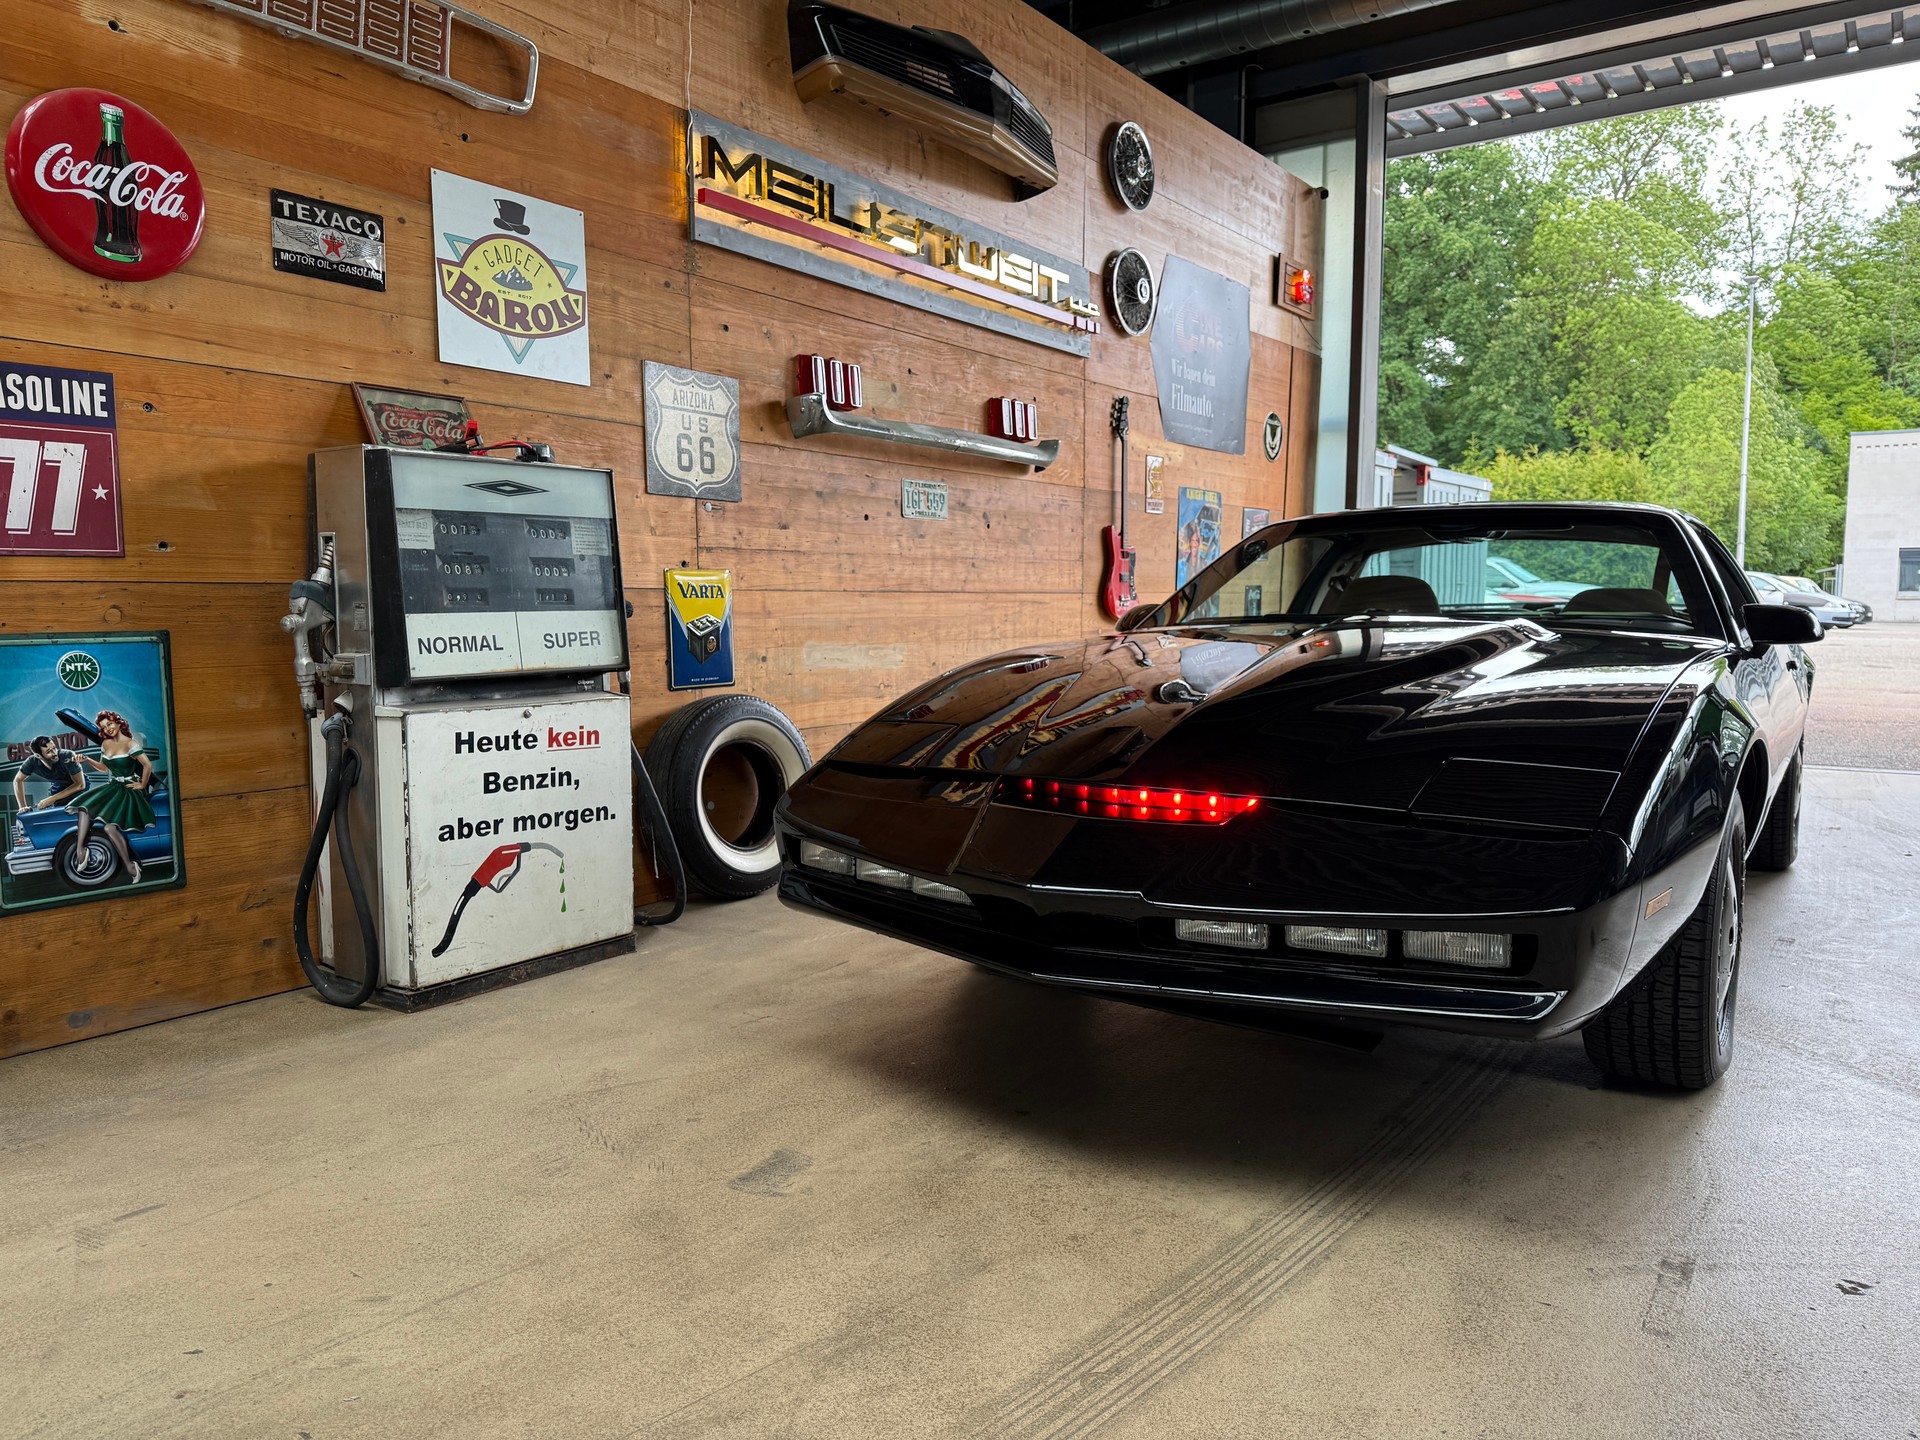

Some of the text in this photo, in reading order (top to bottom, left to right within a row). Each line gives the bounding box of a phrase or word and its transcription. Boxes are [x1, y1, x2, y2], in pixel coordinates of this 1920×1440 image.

[34, 142, 189, 218] Coca-Cola
[277, 198, 382, 240] TEXACO
[280, 251, 384, 282] MOTOR OIL GASOLINE
[483, 244, 545, 278] GADGET
[447, 269, 581, 332] BARON
[672, 388, 715, 411] ARIZONA
[1171, 382, 1214, 418] Filmauto.
[381, 411, 464, 440] Coca-Cola
[676, 433, 716, 475] 66
[677, 581, 725, 599] VARTA
[417, 630, 601, 655] NORMAL SUPER
[65, 662, 92, 673] NTK
[455, 725, 600, 755] Heute kein
[483, 766, 580, 795] Benzin,
[438, 804, 617, 842] aber morgen.
